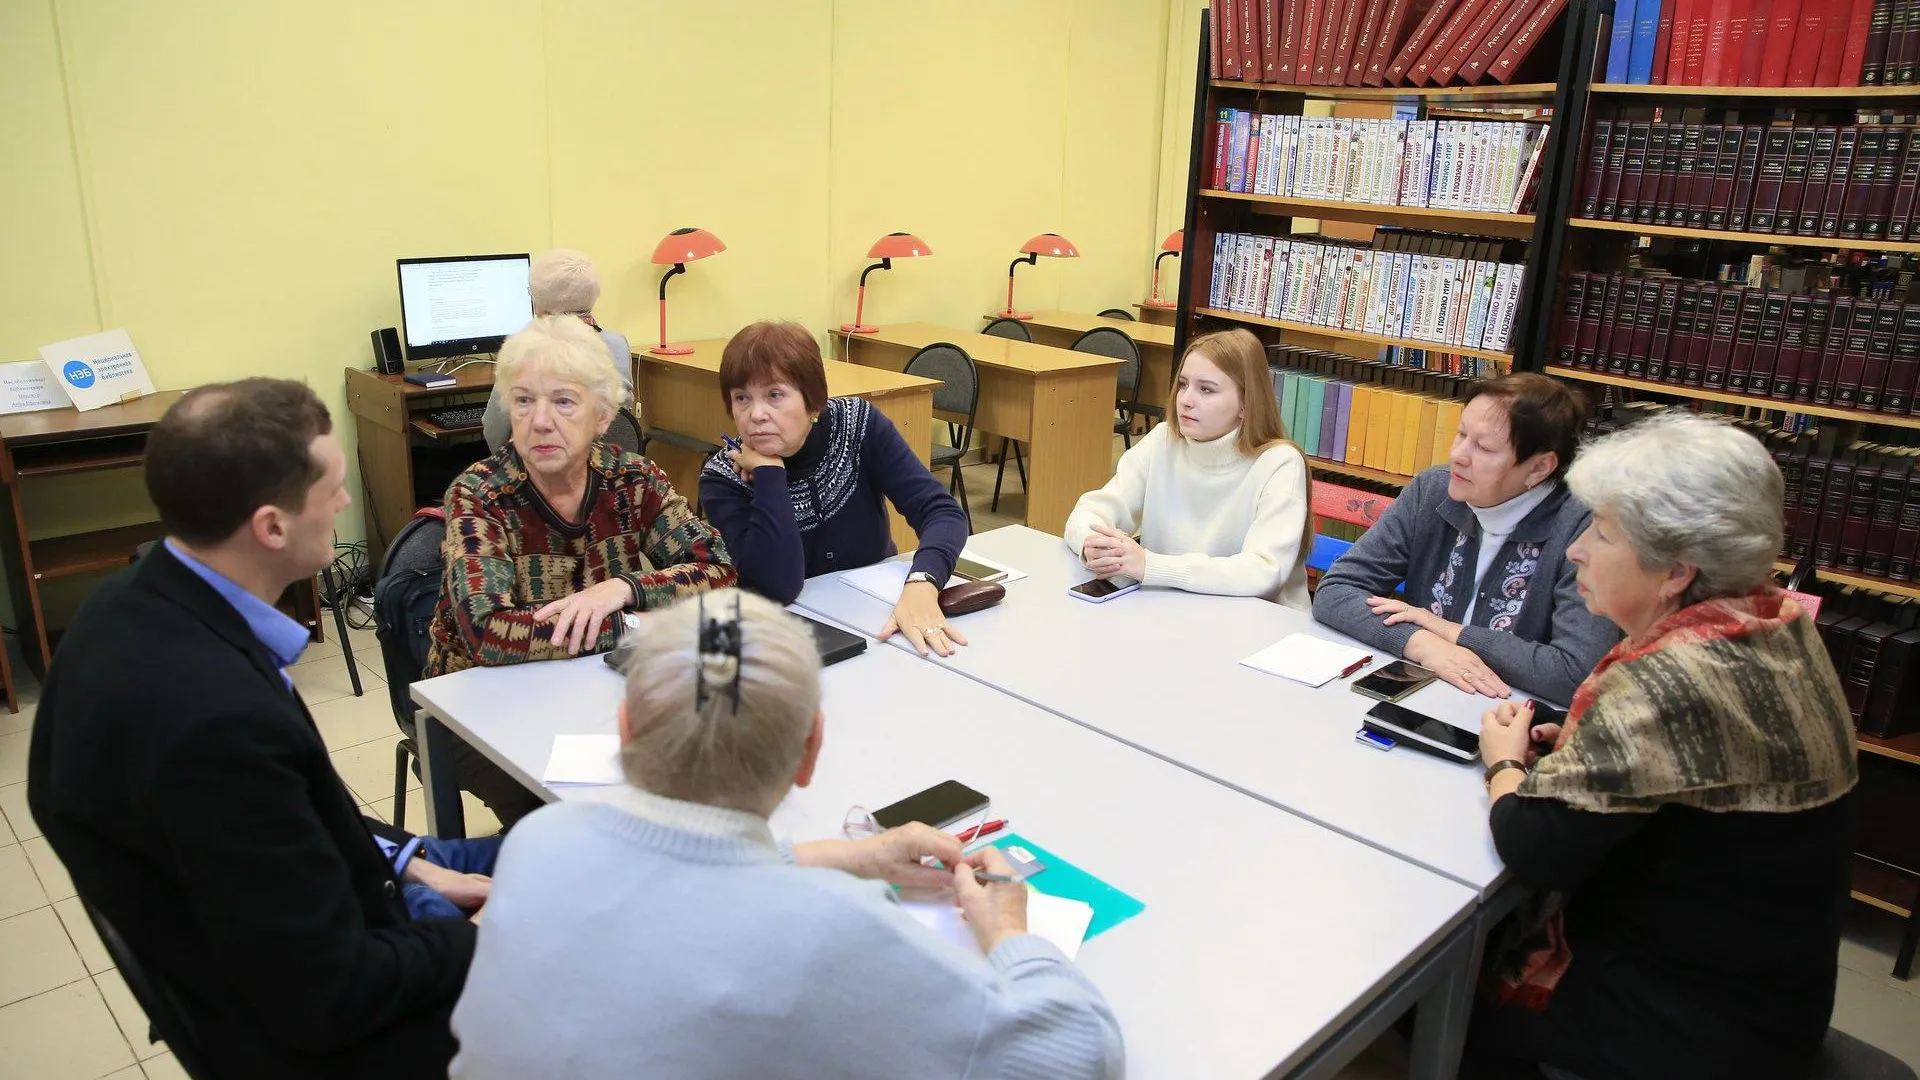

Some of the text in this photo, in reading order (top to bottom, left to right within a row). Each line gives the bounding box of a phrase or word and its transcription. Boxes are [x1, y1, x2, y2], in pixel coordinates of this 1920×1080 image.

[1332, 134, 1340, 152] МИР
[1457, 142, 1465, 159] МИР
[1469, 145, 1477, 162] МИР
[1262, 153, 1271, 183] ПОЗНАЮ
[1303, 152, 1313, 184] ПОЗНАЮ
[1328, 153, 1338, 186] ПОЗНАЮ
[1346, 164, 1355, 192] ПОЗНАЮ
[1402, 160, 1412, 191] ПОЗНАЮ
[1411, 160, 1420, 190] ПОЗНАЮ
[1431, 160, 1441, 191] ПОЗНАЮ
[1441, 161, 1450, 192] ПОЗНАЮ
[1453, 161, 1463, 192] ПОЗНАЮ
[1464, 164, 1475, 196] ПОЗНАЮ
[1253, 253, 1261, 269] МИР
[1286, 261, 1294, 276] МИР
[1295, 259, 1304, 275] МИР
[1304, 262, 1312, 278] МИР
[1319, 265, 1327, 280] МИР
[1335, 266, 1343, 281] МИР
[1239, 272, 1248, 299] ПОЗНАЮ
[1248, 270, 1259, 300] ПОЗНАЮ
[1351, 269, 1360, 285] МИР
[1390, 269, 1400, 299] ПОЗНАЮ
[1409, 276, 1417, 292] МИР
[1418, 278, 1426, 294] МИР
[1442, 278, 1451, 295] МИР
[1282, 278, 1292, 306] ПОЗНАЮ
[1291, 277, 1302, 307] ПОЗНАЮ
[1299, 279, 1310, 309] ПОЗНАЮ
[1308, 288, 1316, 315] ПОЗНАЮ
[1315, 281, 1325, 310] ПОЗНАЮ
[1330, 282, 1341, 311] ПОЗНАЮ
[1346, 287, 1357, 317] ПОЗНАЮ
[1388, 300, 1397, 316] МИР
[1405, 294, 1415, 324] ПОЗНАЮ
[1414, 295, 1424, 325] ПОЗНАЮ
[1437, 296, 1449, 326] ПОЗНАЮ
[1486, 301, 1500, 335] ПОЗНАЮ
[1494, 281, 1504, 299] МИР
[1500, 302, 1514, 335] ПОЗНАЮ
[1507, 282, 1518, 300] МИР
[93, 352, 132, 365] Национальная
[97, 361, 131, 372] электронная
[69, 369, 92, 381] НЭБ
[101, 369, 133, 381] библиотека
